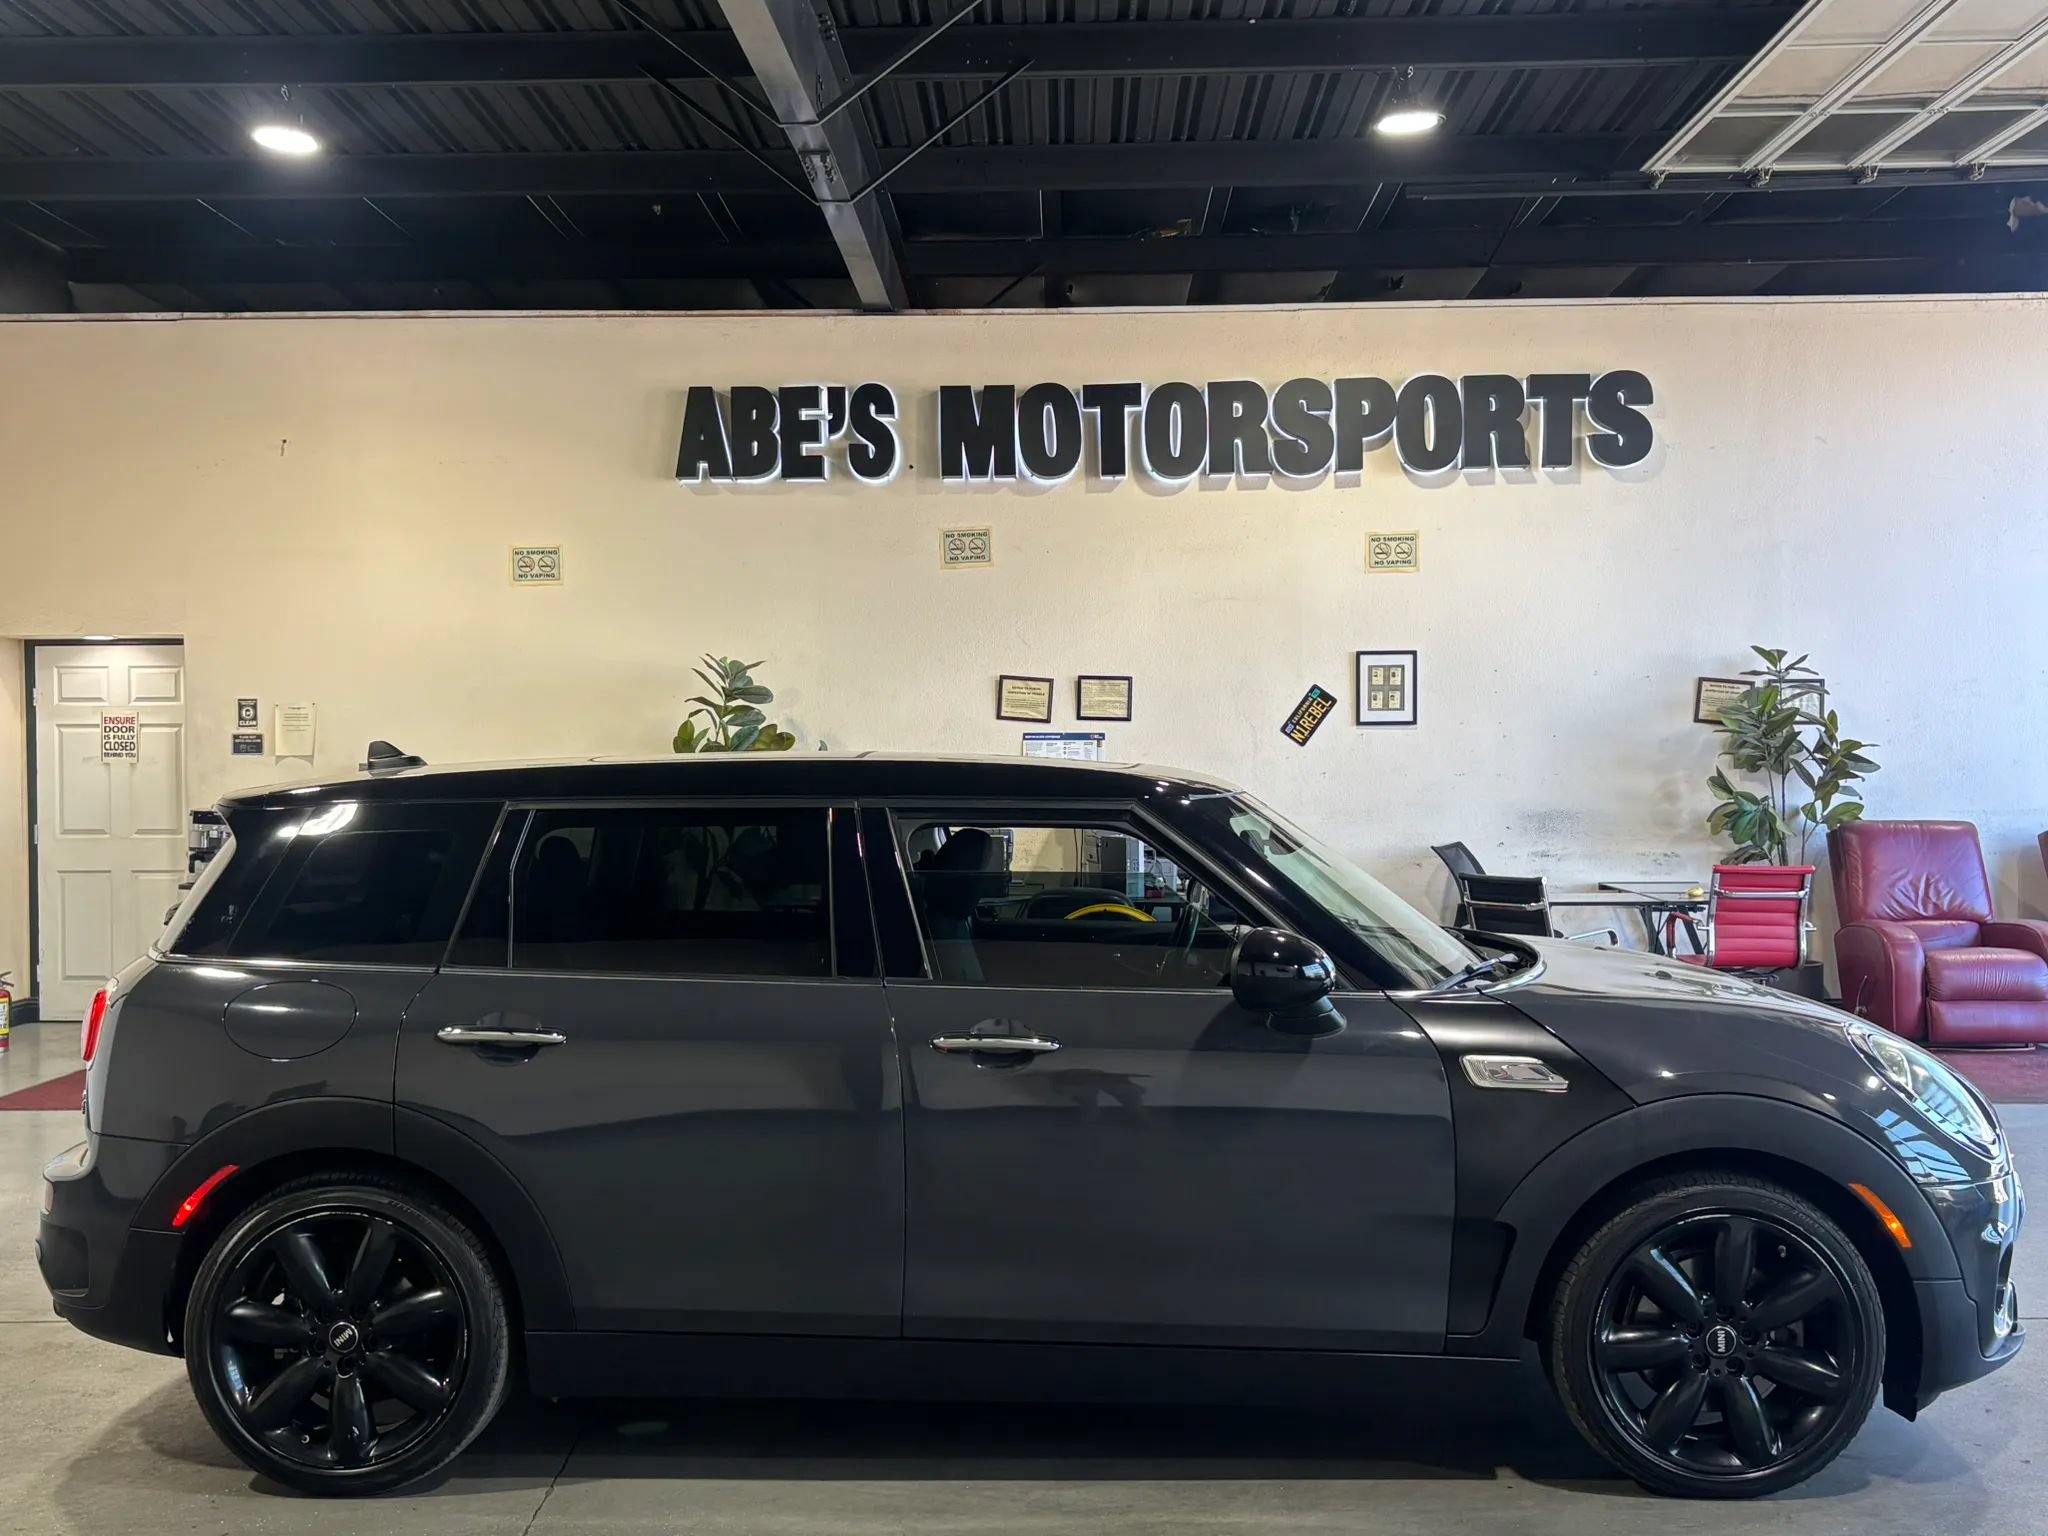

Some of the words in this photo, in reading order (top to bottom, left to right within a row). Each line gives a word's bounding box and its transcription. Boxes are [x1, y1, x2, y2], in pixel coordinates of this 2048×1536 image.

[676, 383, 898, 481] ABE'S
[939, 371, 1654, 481] MOTORSPORTS
[103, 716, 136, 725] ENSURE
[103, 725, 136, 734] DOOR
[1290, 697, 1332, 743] N1REBEL
[103, 741, 136, 752] CLOSED
[334, 1328, 353, 1347] MINI
[1717, 1330, 1726, 1352] MINI
